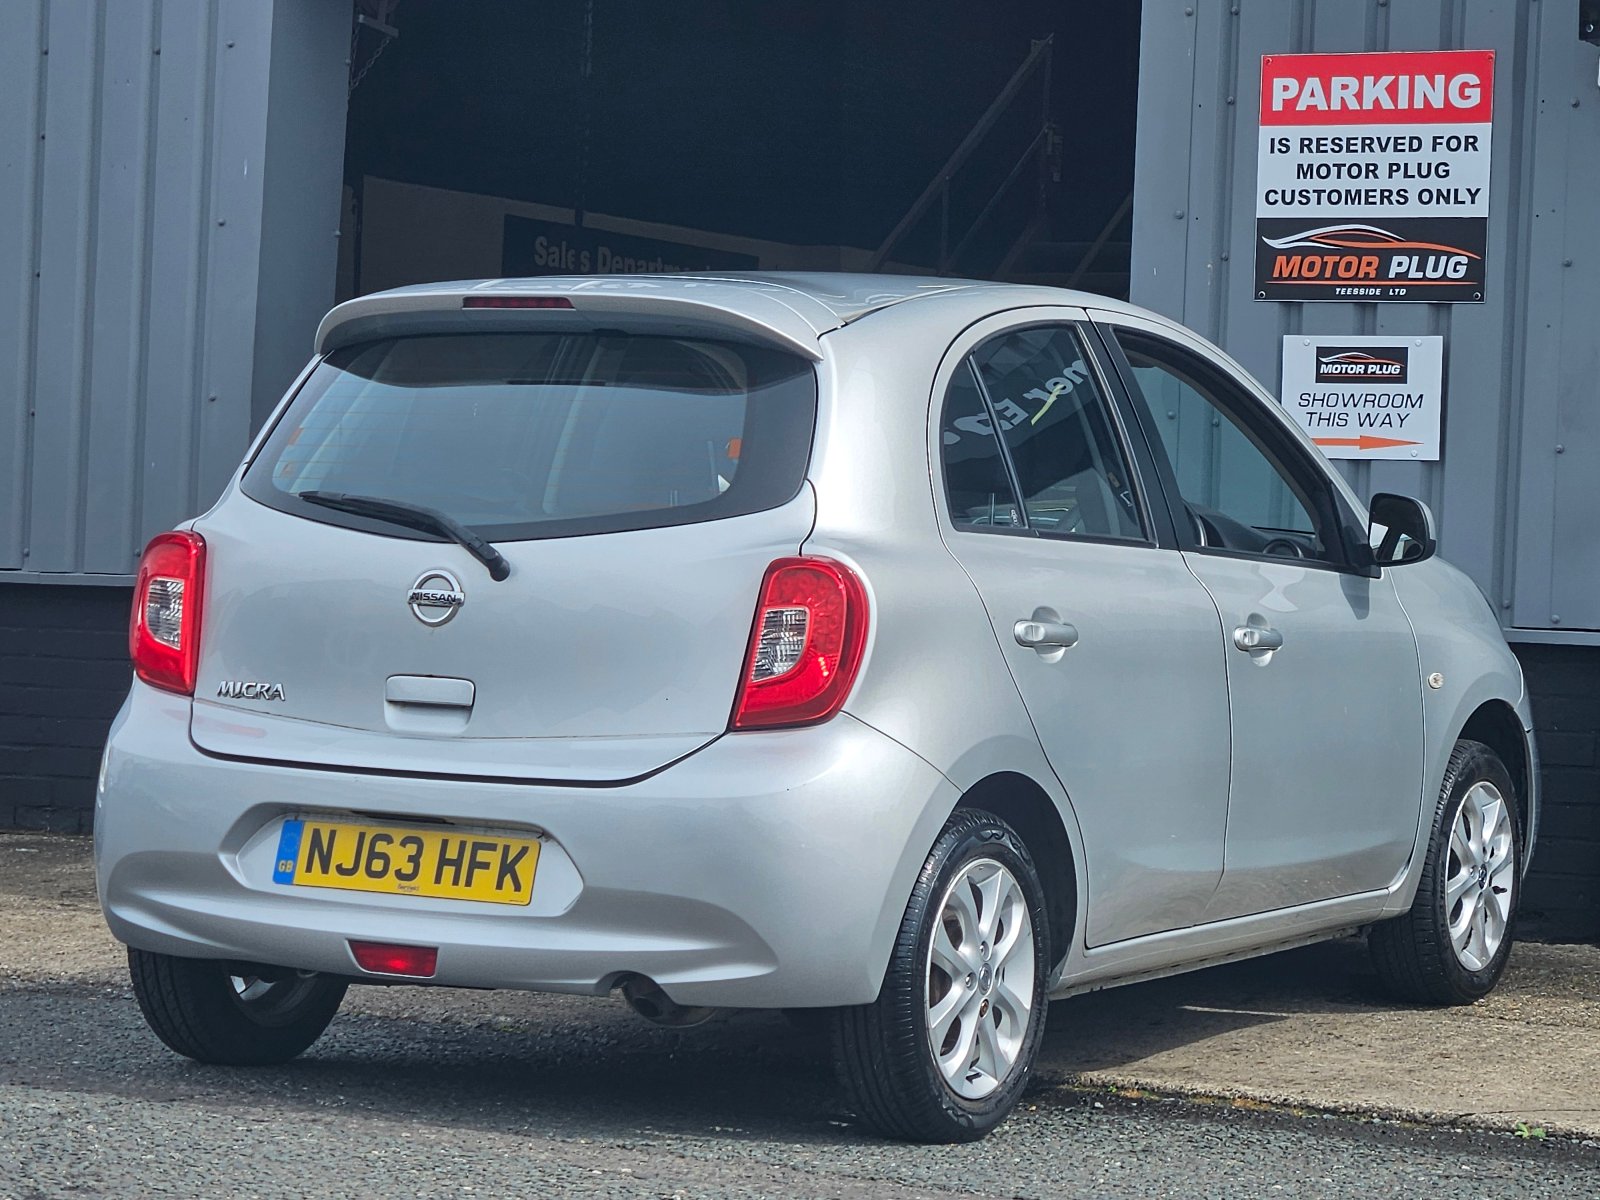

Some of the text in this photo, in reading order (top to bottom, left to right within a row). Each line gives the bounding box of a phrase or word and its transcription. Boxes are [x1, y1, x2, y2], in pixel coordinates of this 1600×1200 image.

[1271, 74, 1481, 112] PARKING
[1269, 135, 1479, 154] IS RESERVED FOR
[1296, 162, 1450, 180] MOTOR PLUG
[1264, 187, 1481, 206] CUSTOMERS ONLY
[1272, 255, 1469, 279] MOTOR PLUG
[1335, 288, 1407, 296] TEESSIDE LTD
[1319, 364, 1401, 375] MOTOR PLUG
[1298, 392, 1424, 409] SHOWROOM
[1306, 412, 1411, 428] THIS WAY
[409, 591, 457, 603] NISSAN
[216, 680, 286, 702] MICRA
[278, 859, 294, 873] GB
[304, 827, 530, 893] NJ63 HFK
